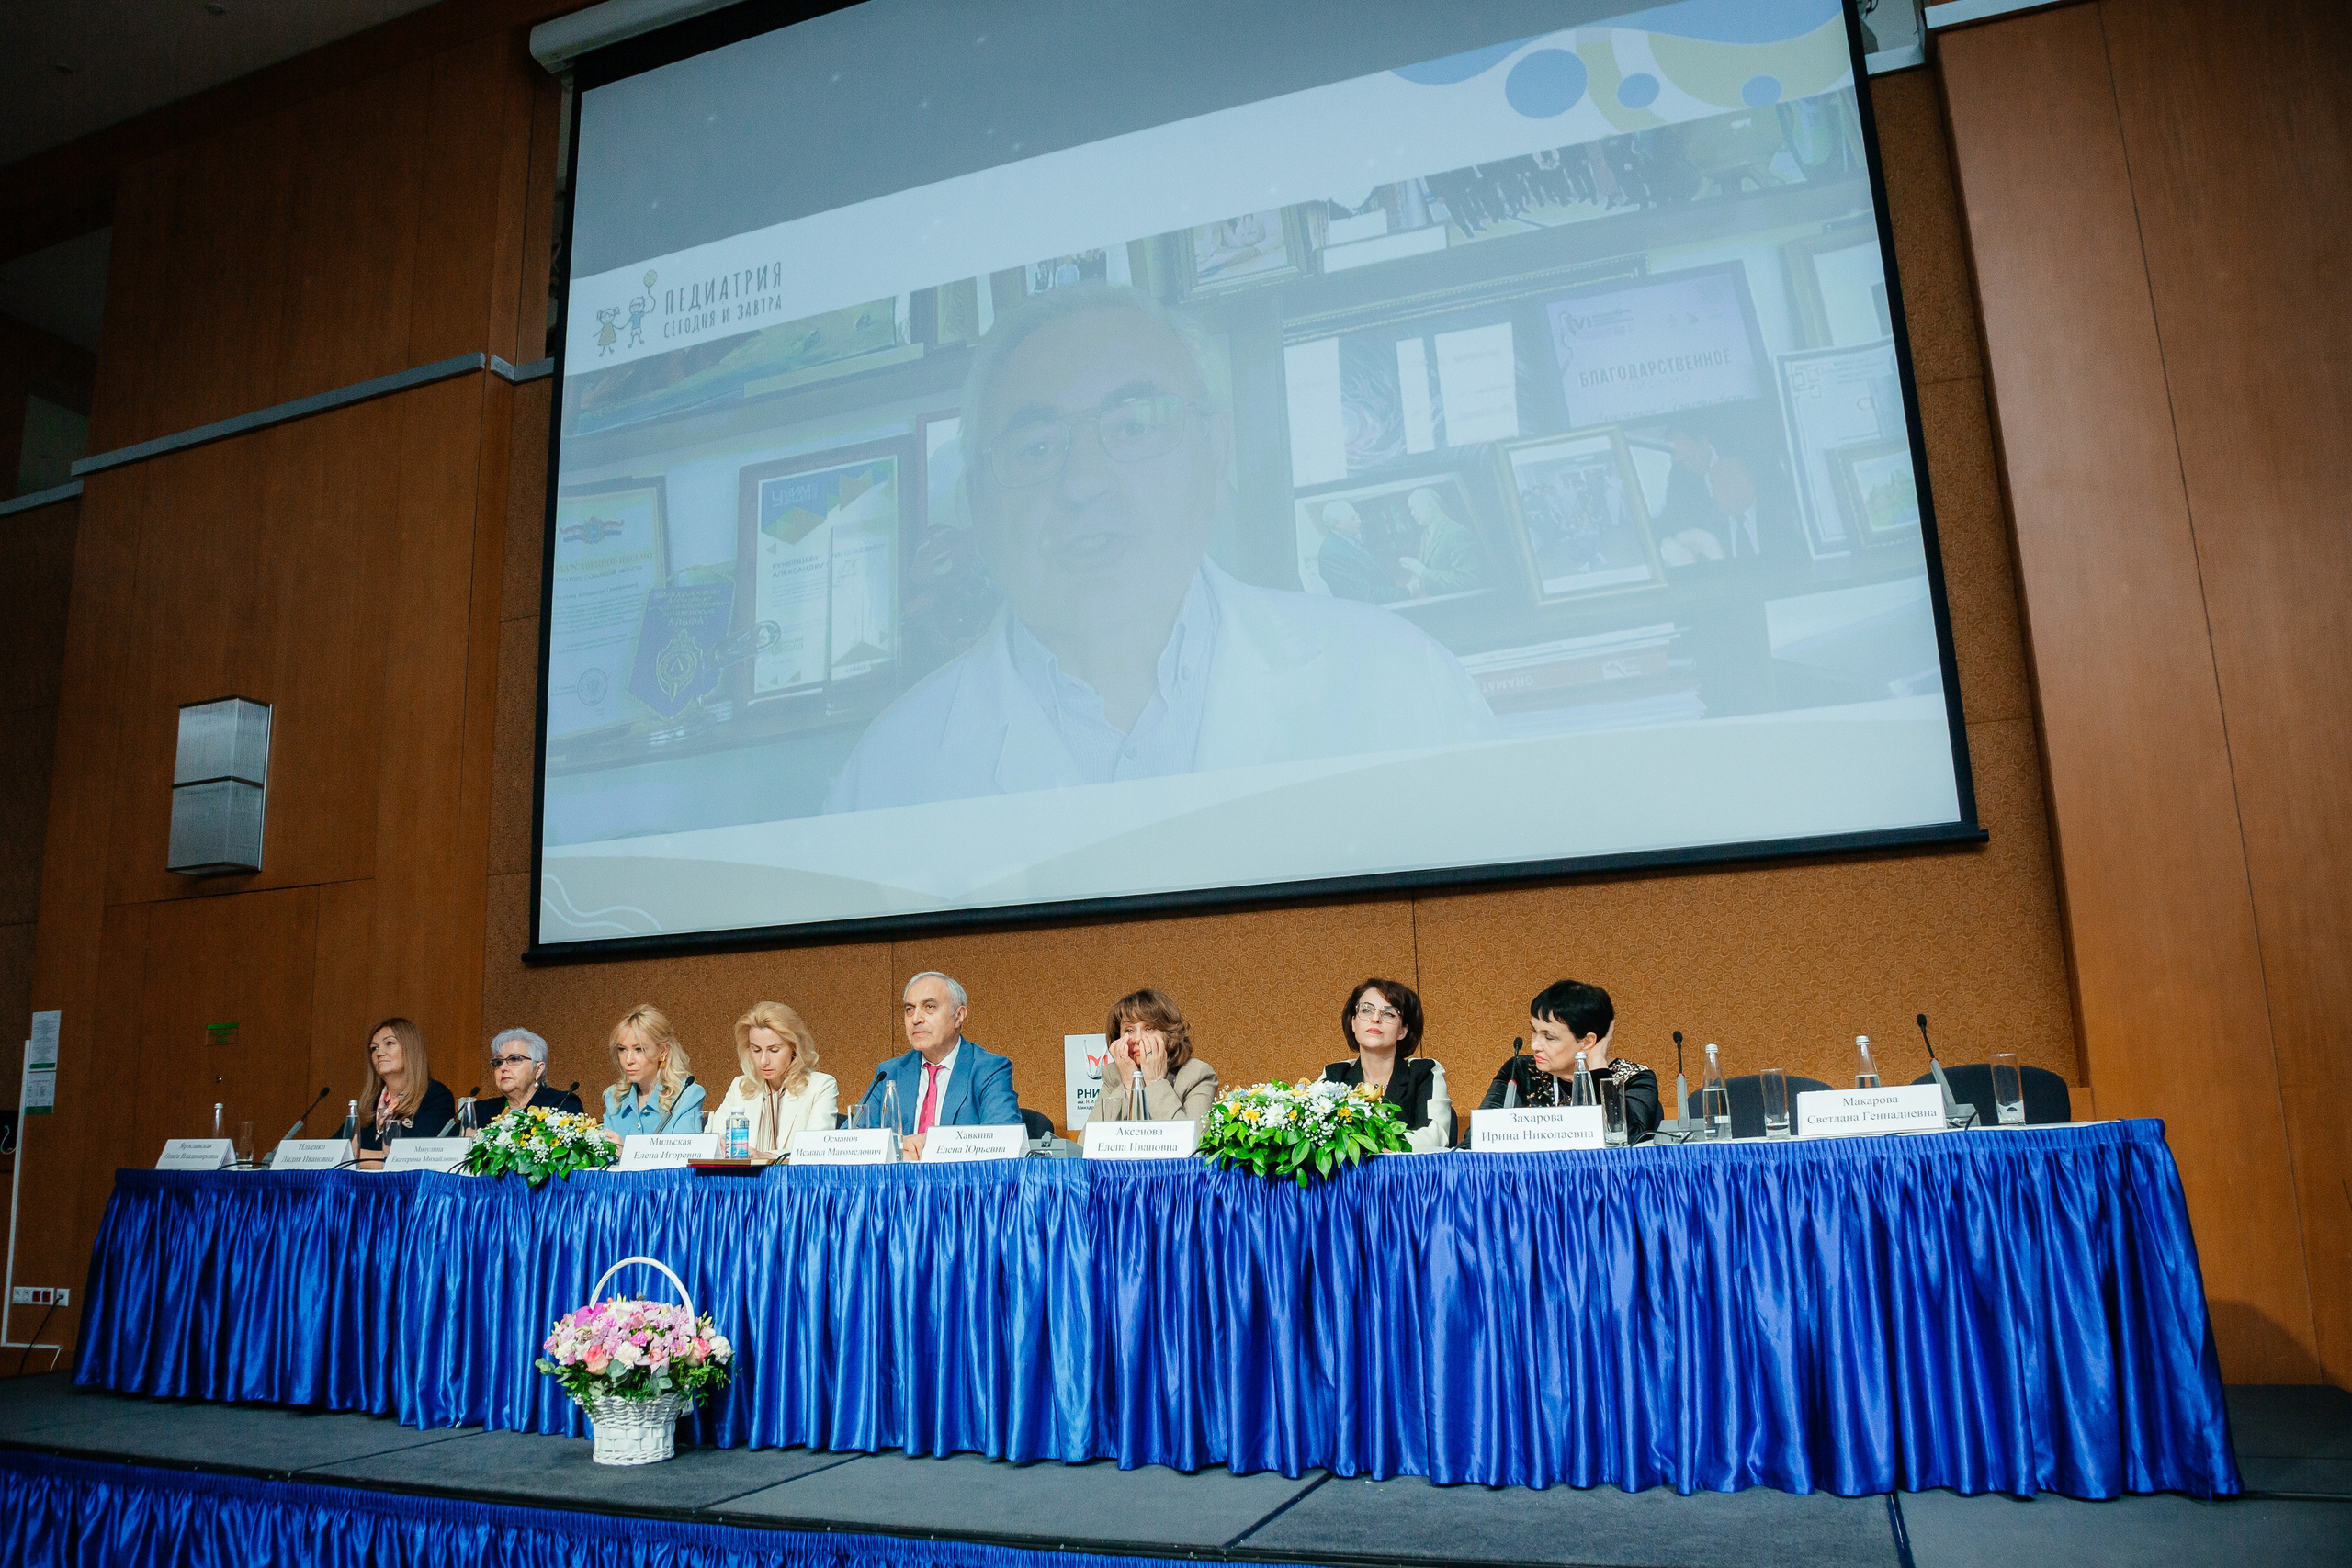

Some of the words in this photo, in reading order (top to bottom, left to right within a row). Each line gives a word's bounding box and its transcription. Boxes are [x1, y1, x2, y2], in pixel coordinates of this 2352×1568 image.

[665, 261, 781, 316] ПЕДИАТРИЯ
[663, 310, 716, 339] СЕГОДНЯ
[722, 307, 729, 324] И
[738, 294, 782, 321] ЗАВТРА
[1579, 348, 1734, 388] БЛАГОДАРСТВЕННОЕ
[1077, 1088, 1100, 1099] РНИ
[1842, 1096, 1899, 1107] Макарова
[1510, 1112, 1564, 1124] Захарова
[1807, 1113, 1860, 1124] Светлана
[1862, 1109, 1938, 1122] Геннадиевна
[956, 1130, 994, 1140] Хавкина
[1115, 1126, 1163, 1136] Аксенова
[650, 1137, 692, 1146] Мильская
[823, 1134, 858, 1143] Османов
[1481, 1131, 1519, 1144] Ирина
[1522, 1129, 1594, 1141] Николаевна
[298, 1143, 326, 1151] Ильенко
[796, 1148, 826, 1156] Исмаил
[827, 1147, 882, 1156] Магомедович
[936, 1145, 963, 1154] Елена
[965, 1145, 1006, 1156] Юрьевна
[1097, 1142, 1126, 1152] Елена
[1129, 1142, 1178, 1152] Ивановна
[281, 1155, 301, 1163] Лидия
[302, 1155, 334, 1163] Ивановна
[634, 1151, 659, 1159] Елена
[661, 1151, 702, 1161] Игоревна
